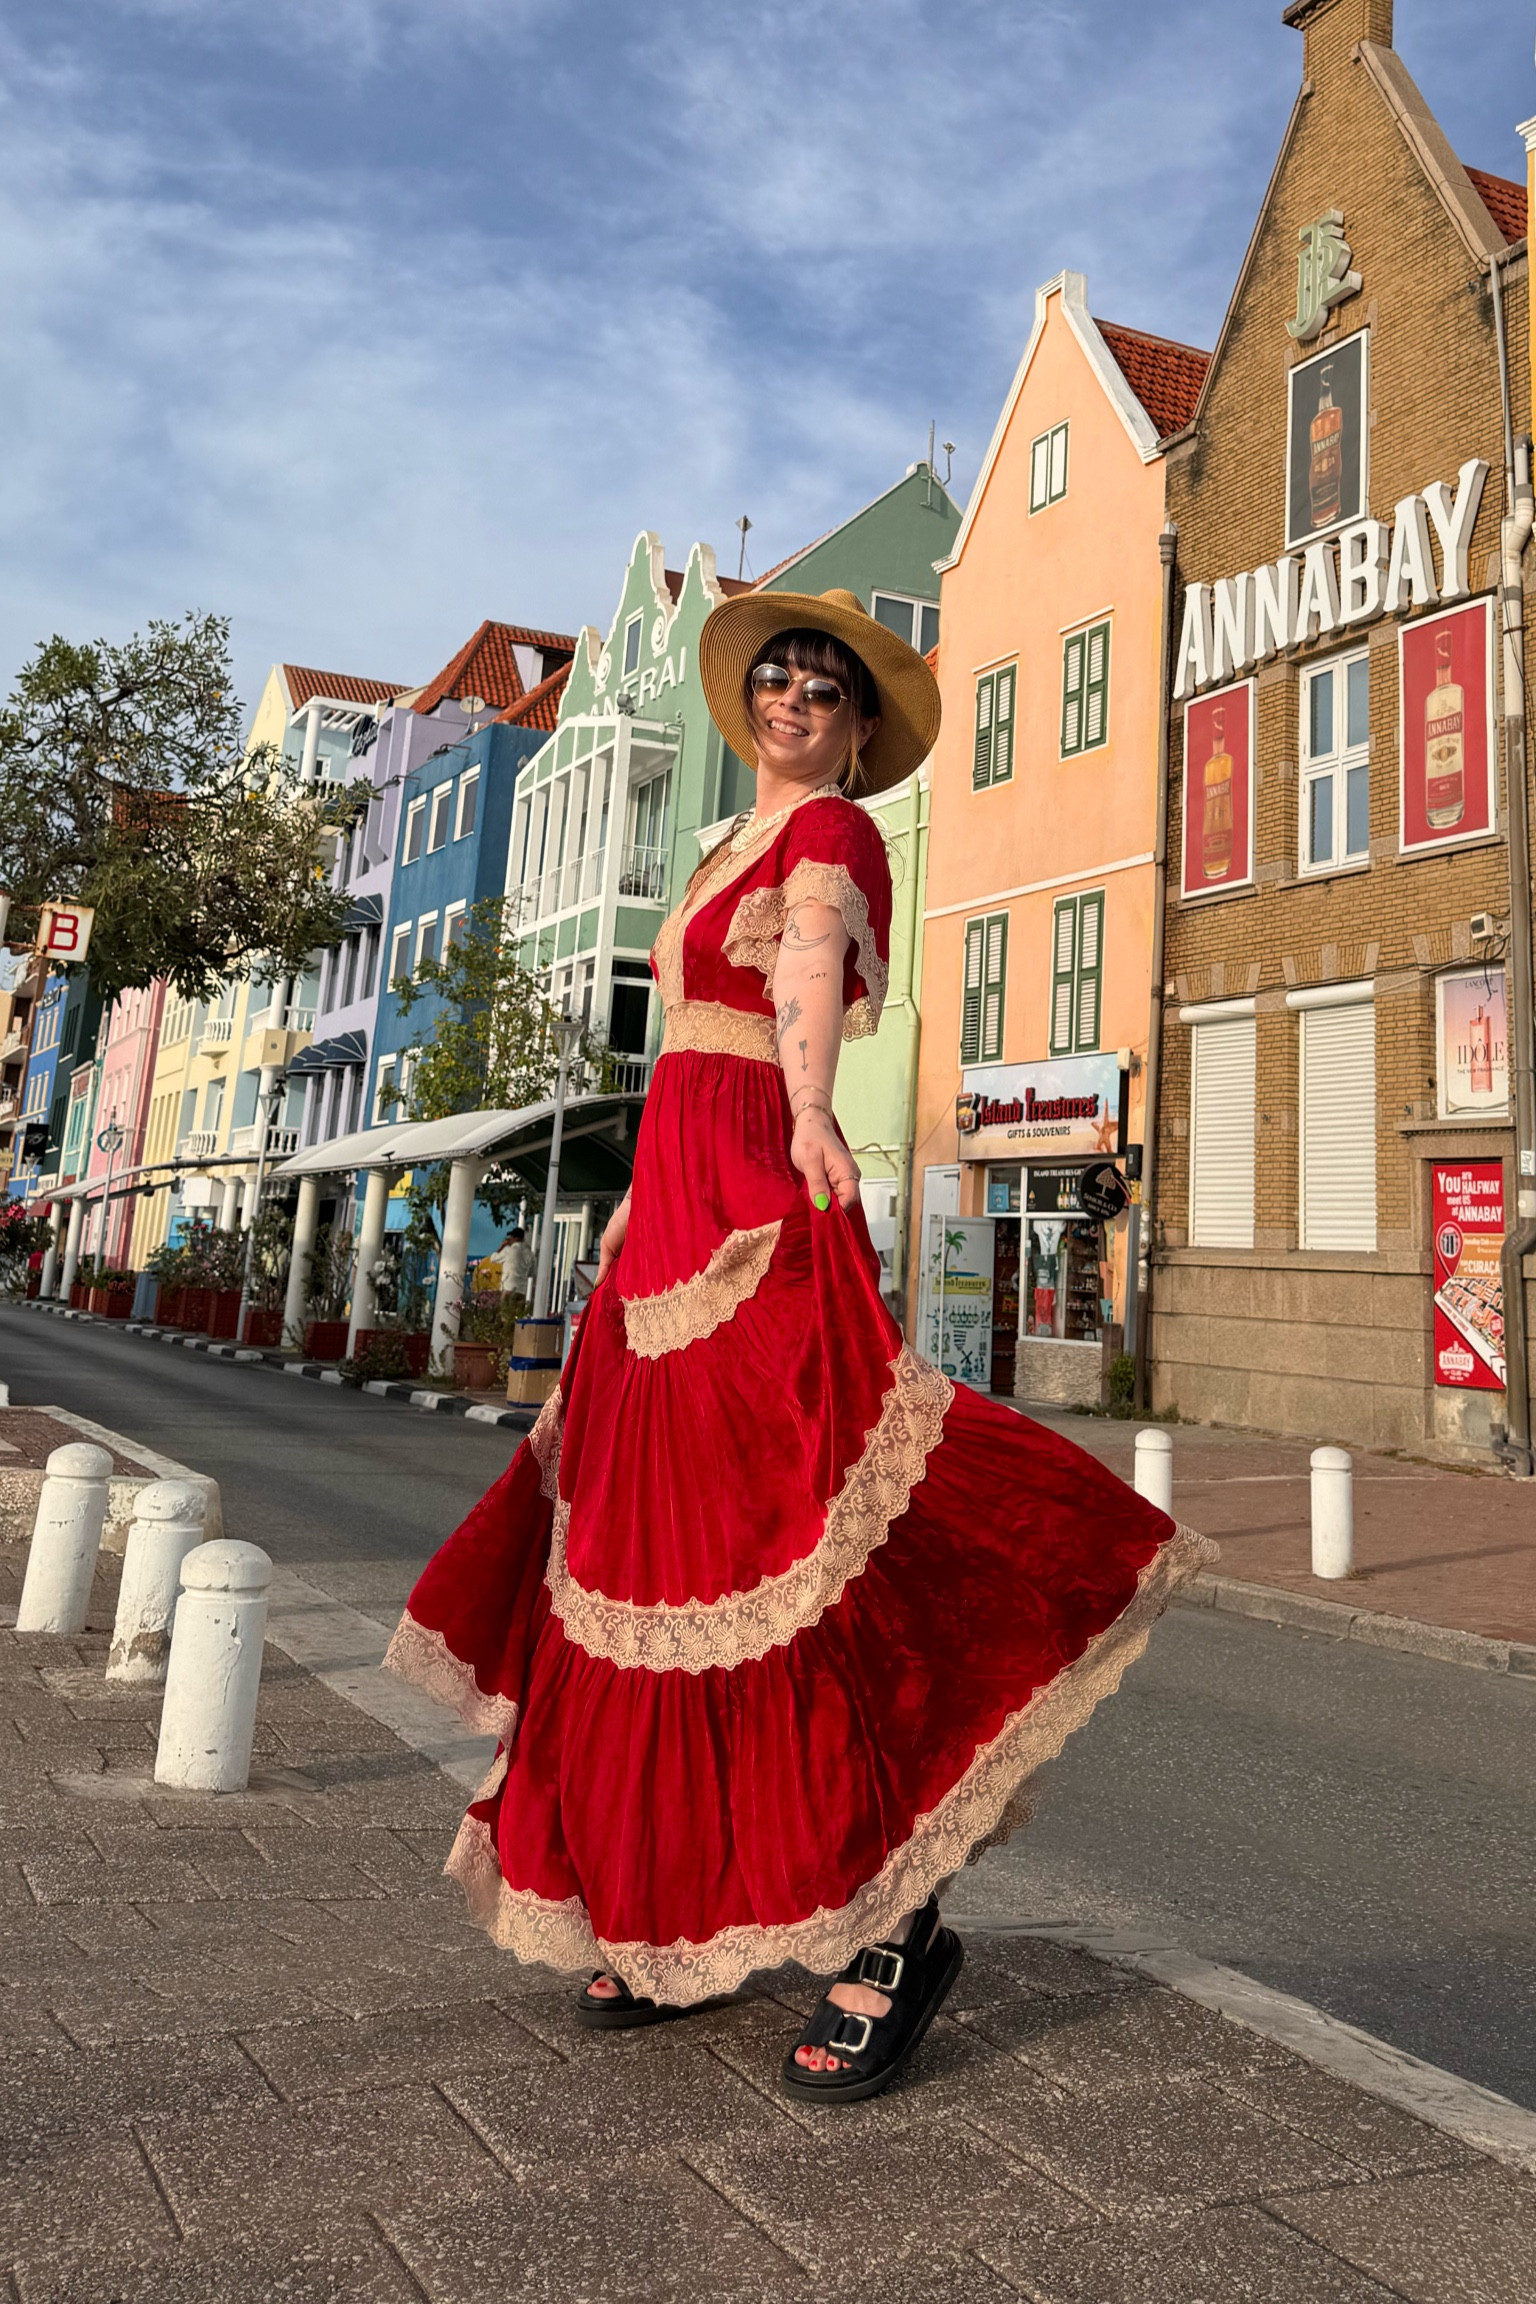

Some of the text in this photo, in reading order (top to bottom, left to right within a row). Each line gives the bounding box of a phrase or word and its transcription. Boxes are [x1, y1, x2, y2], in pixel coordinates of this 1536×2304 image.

[1173, 458, 1490, 700] ANNABAY
[1427, 715, 1462, 738] ANNABAY
[48, 911, 79, 951] B
[1458, 1038, 1505, 1065] IDÔLE
[979, 1087, 1099, 1127] Island Treasures
[1007, 1126, 1071, 1139] GIFTS & SOUVENIRS
[1462, 1171, 1473, 1180] are
[1462, 1180, 1500, 1194] HALFWAY
[1458, 1206, 1503, 1222] ANNABAY
[1468, 1260, 1501, 1276] CURAÇA
